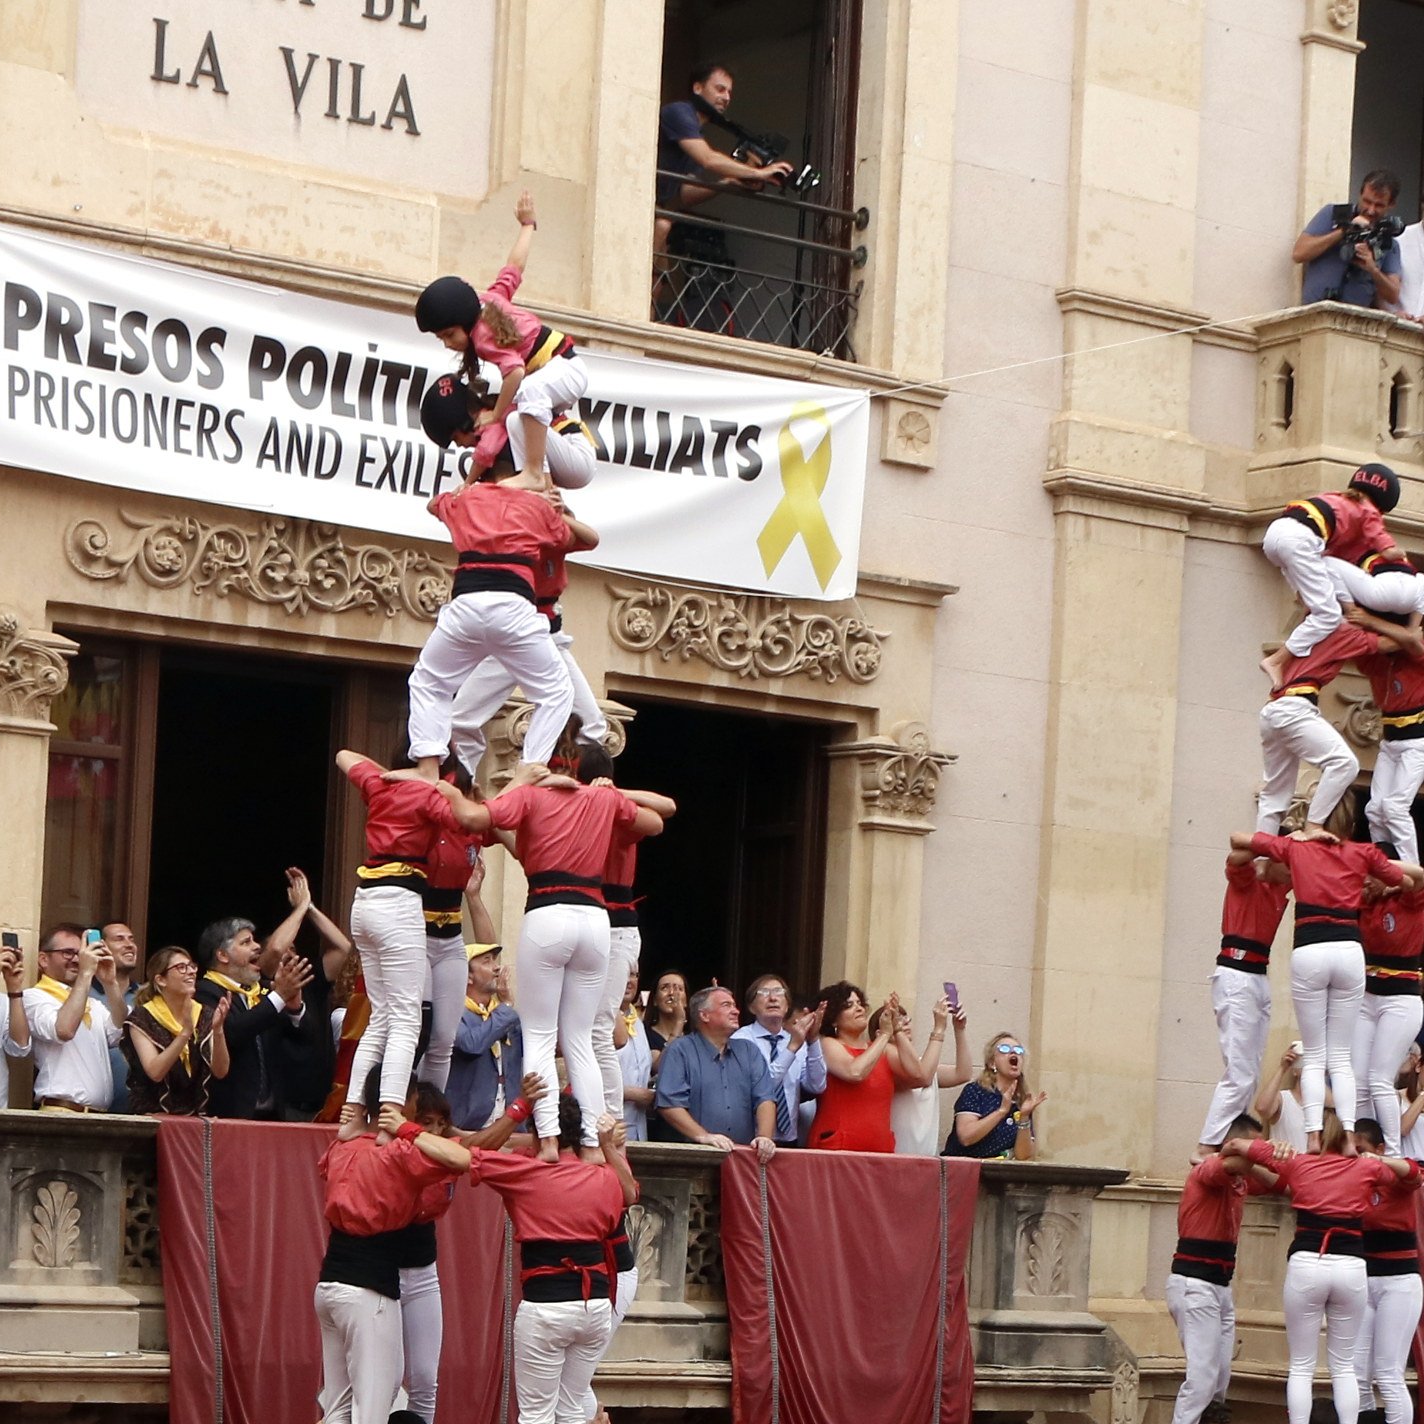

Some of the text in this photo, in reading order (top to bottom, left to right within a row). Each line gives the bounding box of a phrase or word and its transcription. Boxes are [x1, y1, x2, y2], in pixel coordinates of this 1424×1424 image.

[150, 18, 421, 136] LA VILA
[3, 280, 227, 391] PRESOS
[248, 334, 429, 430] POLÍTI
[578, 397, 764, 483] XILIATS
[8, 363, 246, 464] PRISIONERS
[256, 416, 343, 480] AND
[1354, 471, 1388, 492] ELBA
